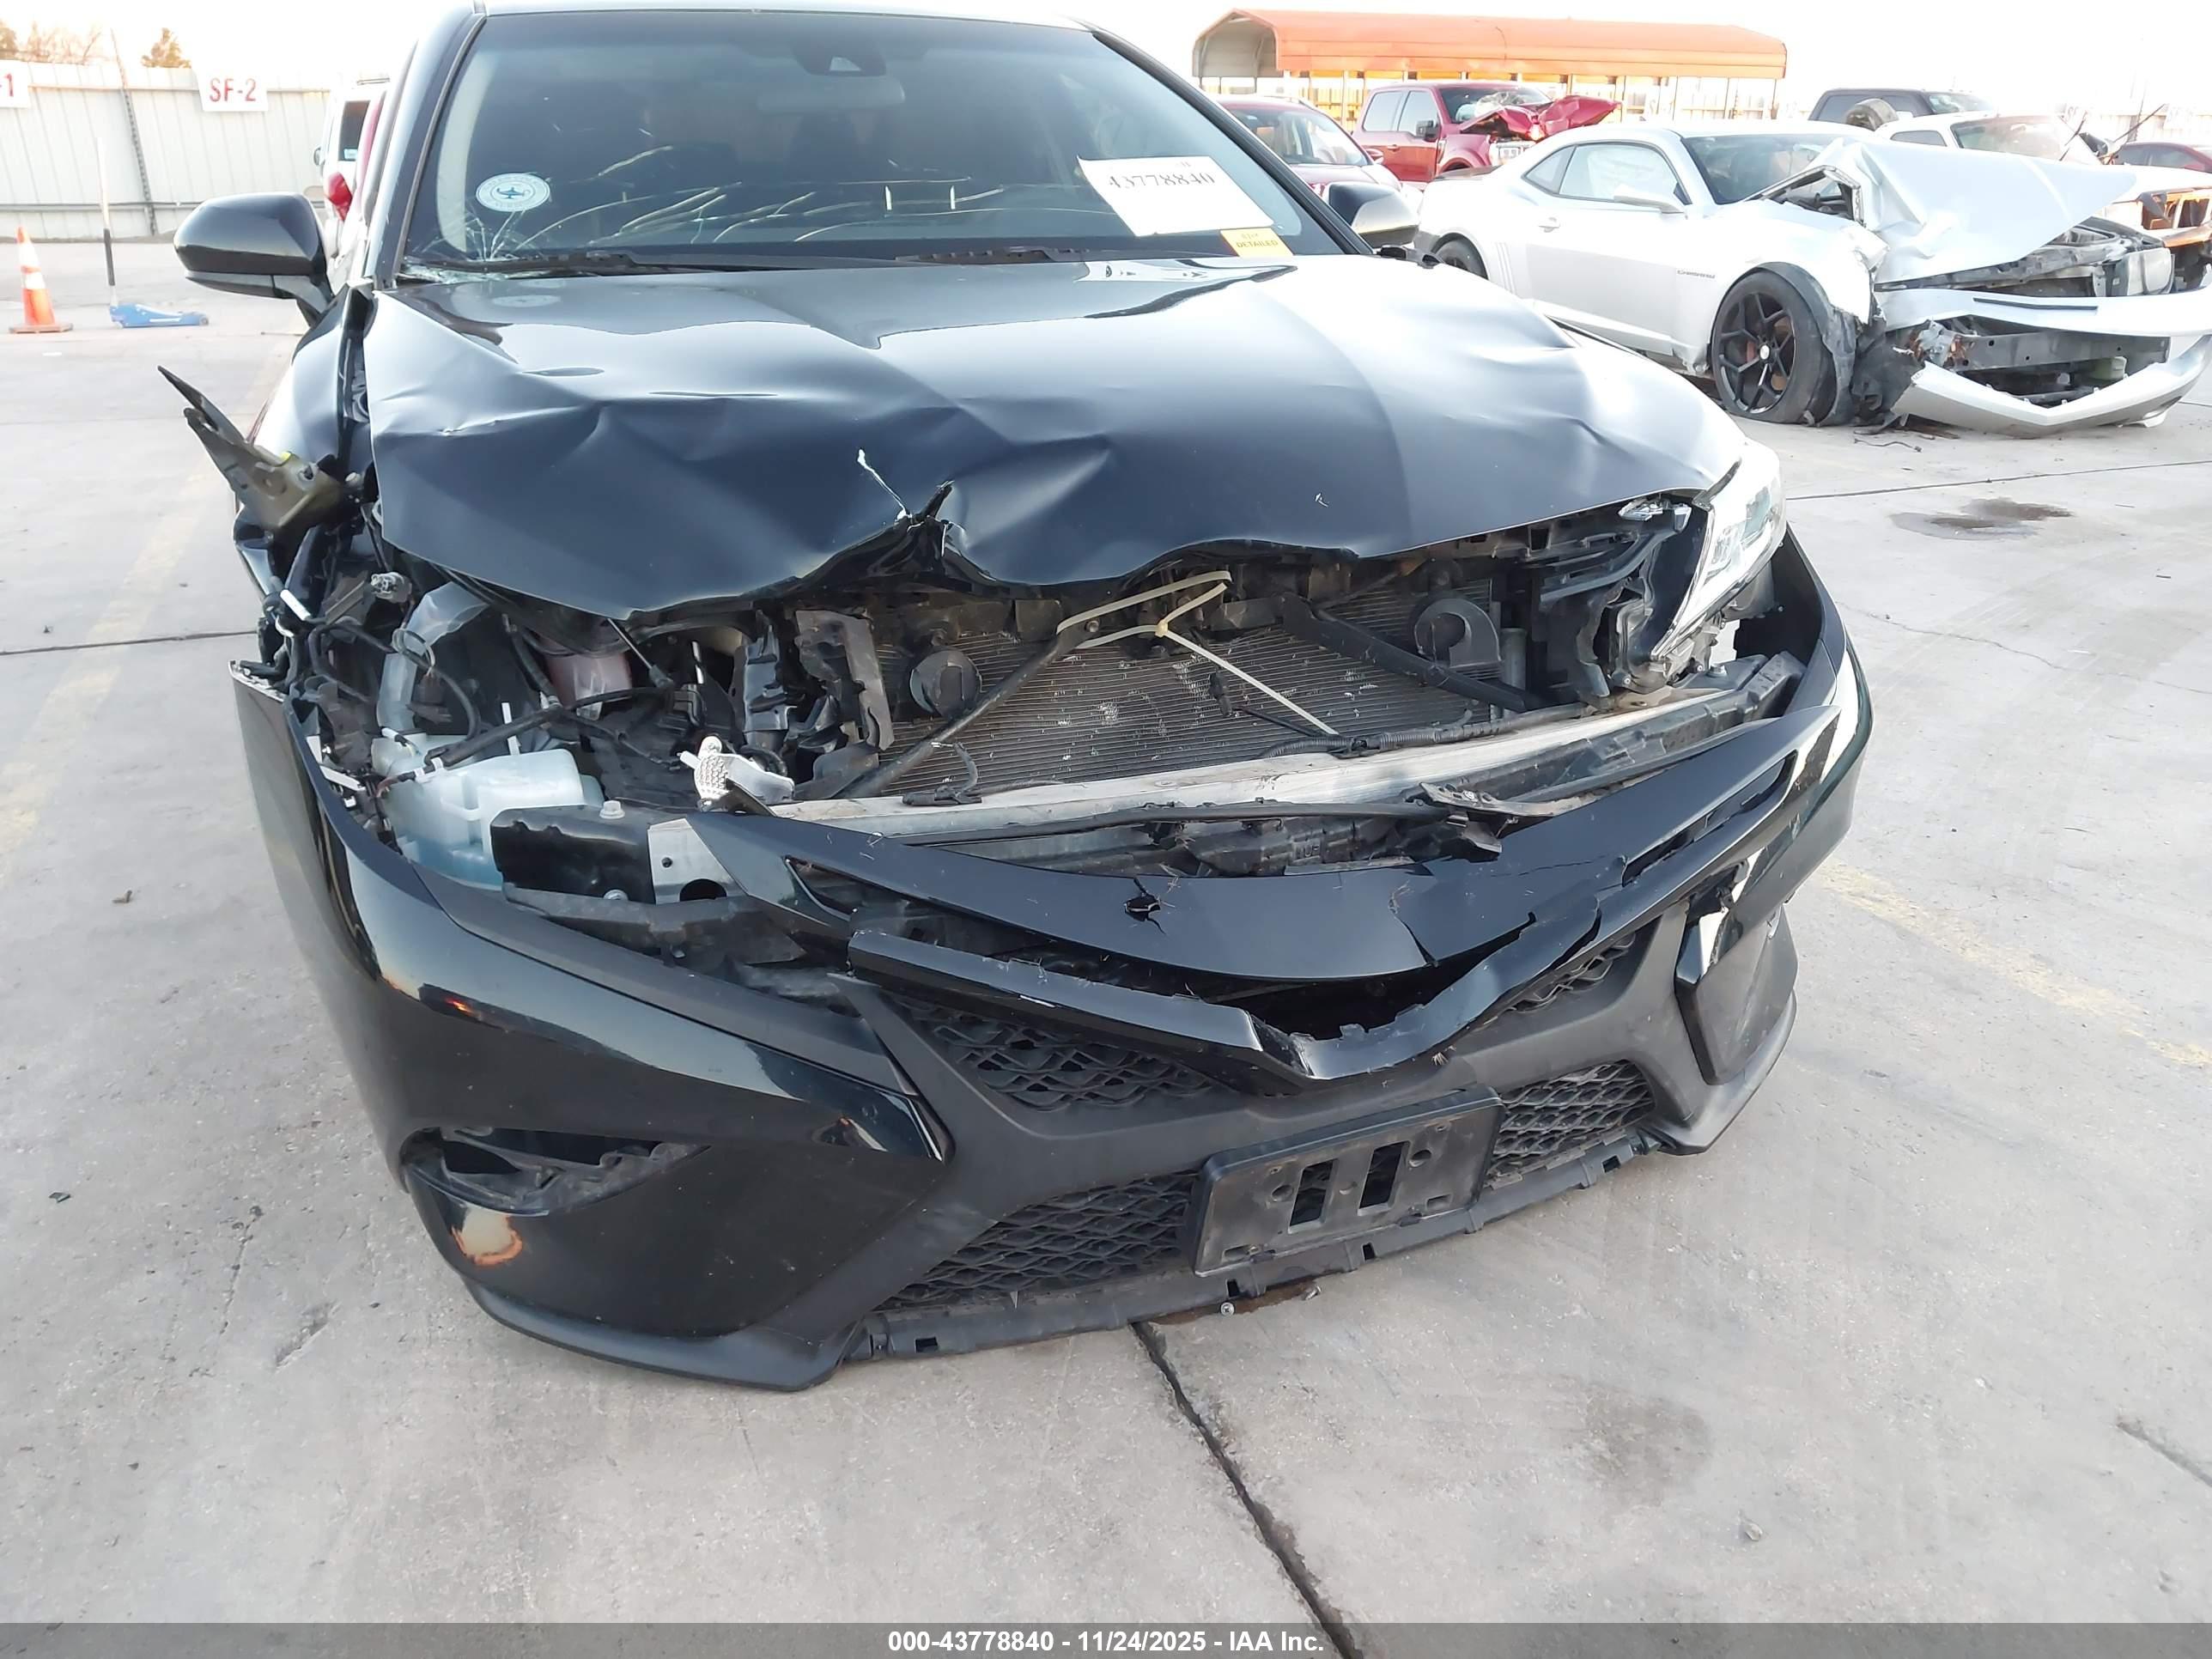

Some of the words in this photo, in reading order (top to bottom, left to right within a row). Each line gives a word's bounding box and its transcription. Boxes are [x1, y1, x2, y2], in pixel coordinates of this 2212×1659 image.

[209, 77, 257, 102] SF-2
[1109, 173, 1215, 188] 43778840
[1236, 240, 1279, 248] DETAILED
